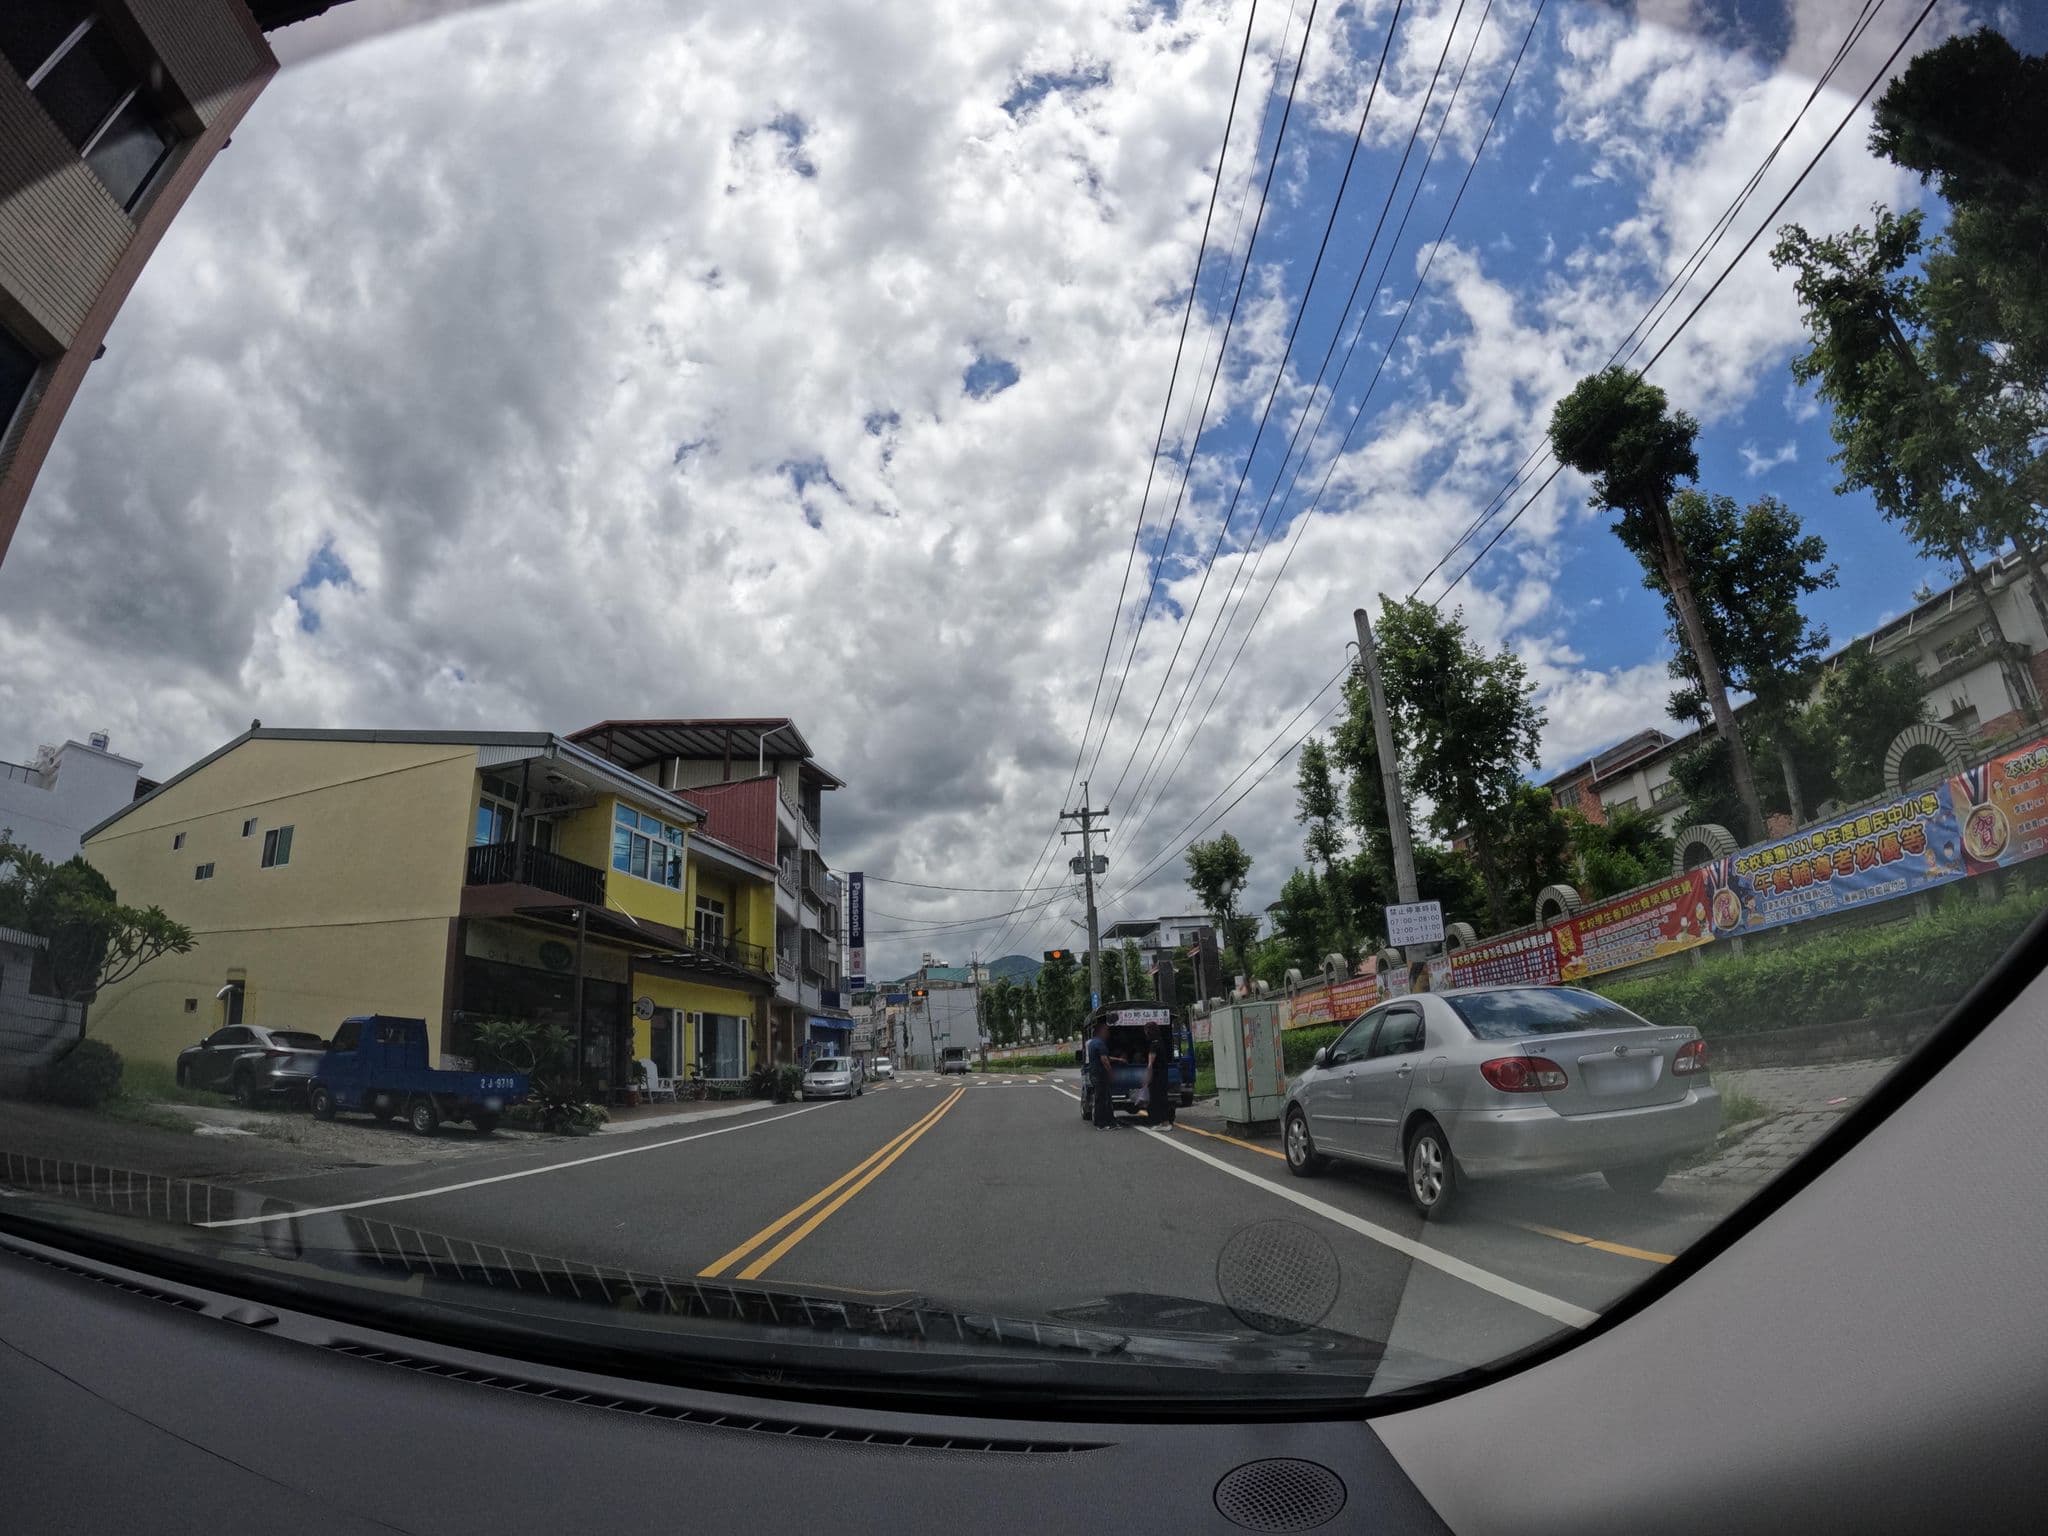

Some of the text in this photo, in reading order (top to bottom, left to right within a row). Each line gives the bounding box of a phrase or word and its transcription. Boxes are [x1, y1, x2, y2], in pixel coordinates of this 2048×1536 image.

[1736, 793, 1939, 875] 本校榮獲111學年度國民中小學
[1973, 814, 1999, 850] 賀
[1754, 824, 1927, 896] 午餐輔導考核優等
[852, 882, 861, 937] Panasonic
[1389, 904, 1438, 915] 禁止停車時段
[1390, 914, 1440, 925] 07:00-08:00
